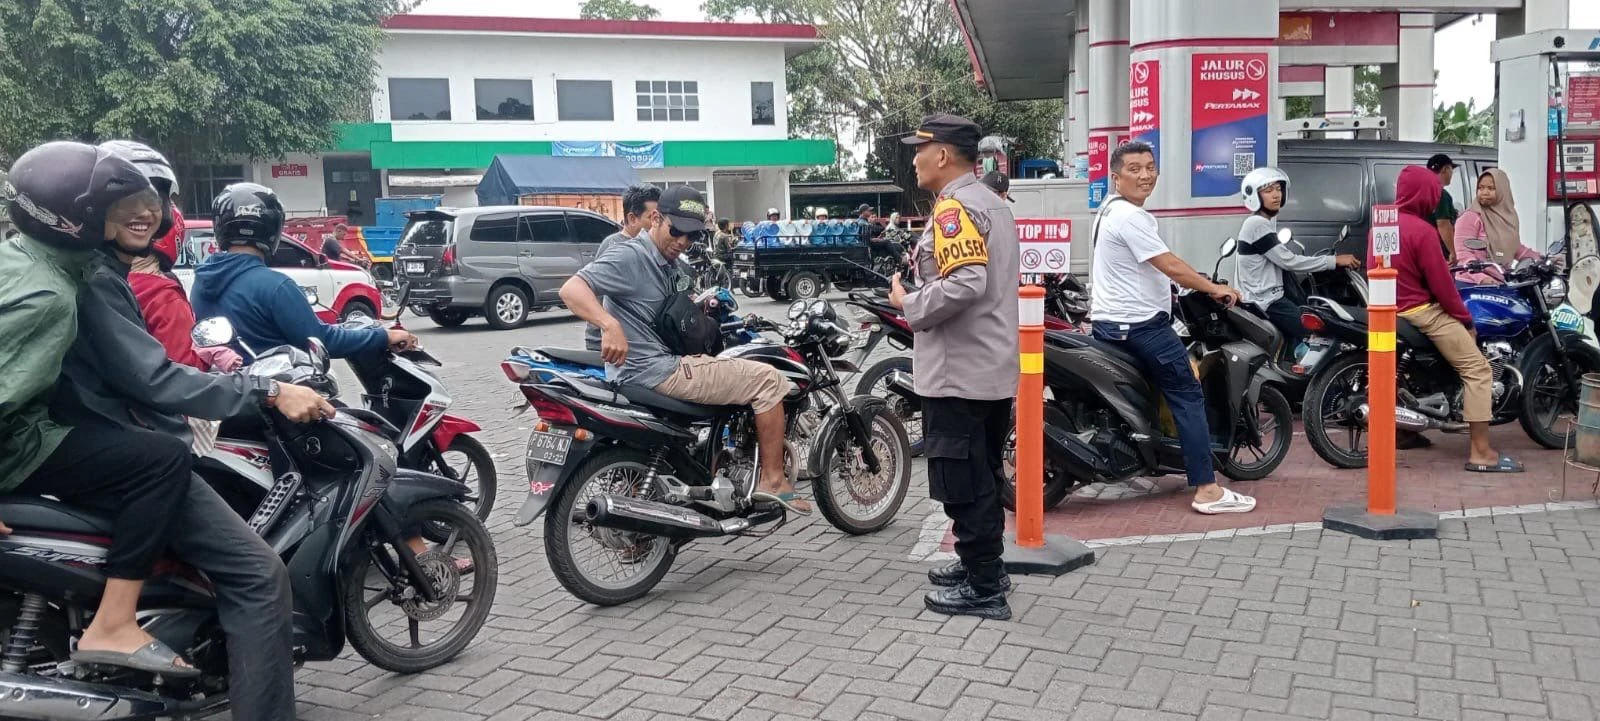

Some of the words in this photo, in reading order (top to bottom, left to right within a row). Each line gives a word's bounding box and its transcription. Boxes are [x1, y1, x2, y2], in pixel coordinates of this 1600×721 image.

[1200, 60, 1245, 71] JALUR
[1200, 71, 1245, 81] KHUSUS
[1203, 102, 1261, 110] PERTAMAX
[1016, 224, 1042, 239] TOP
[1469, 294, 1509, 305] SUZUKI
